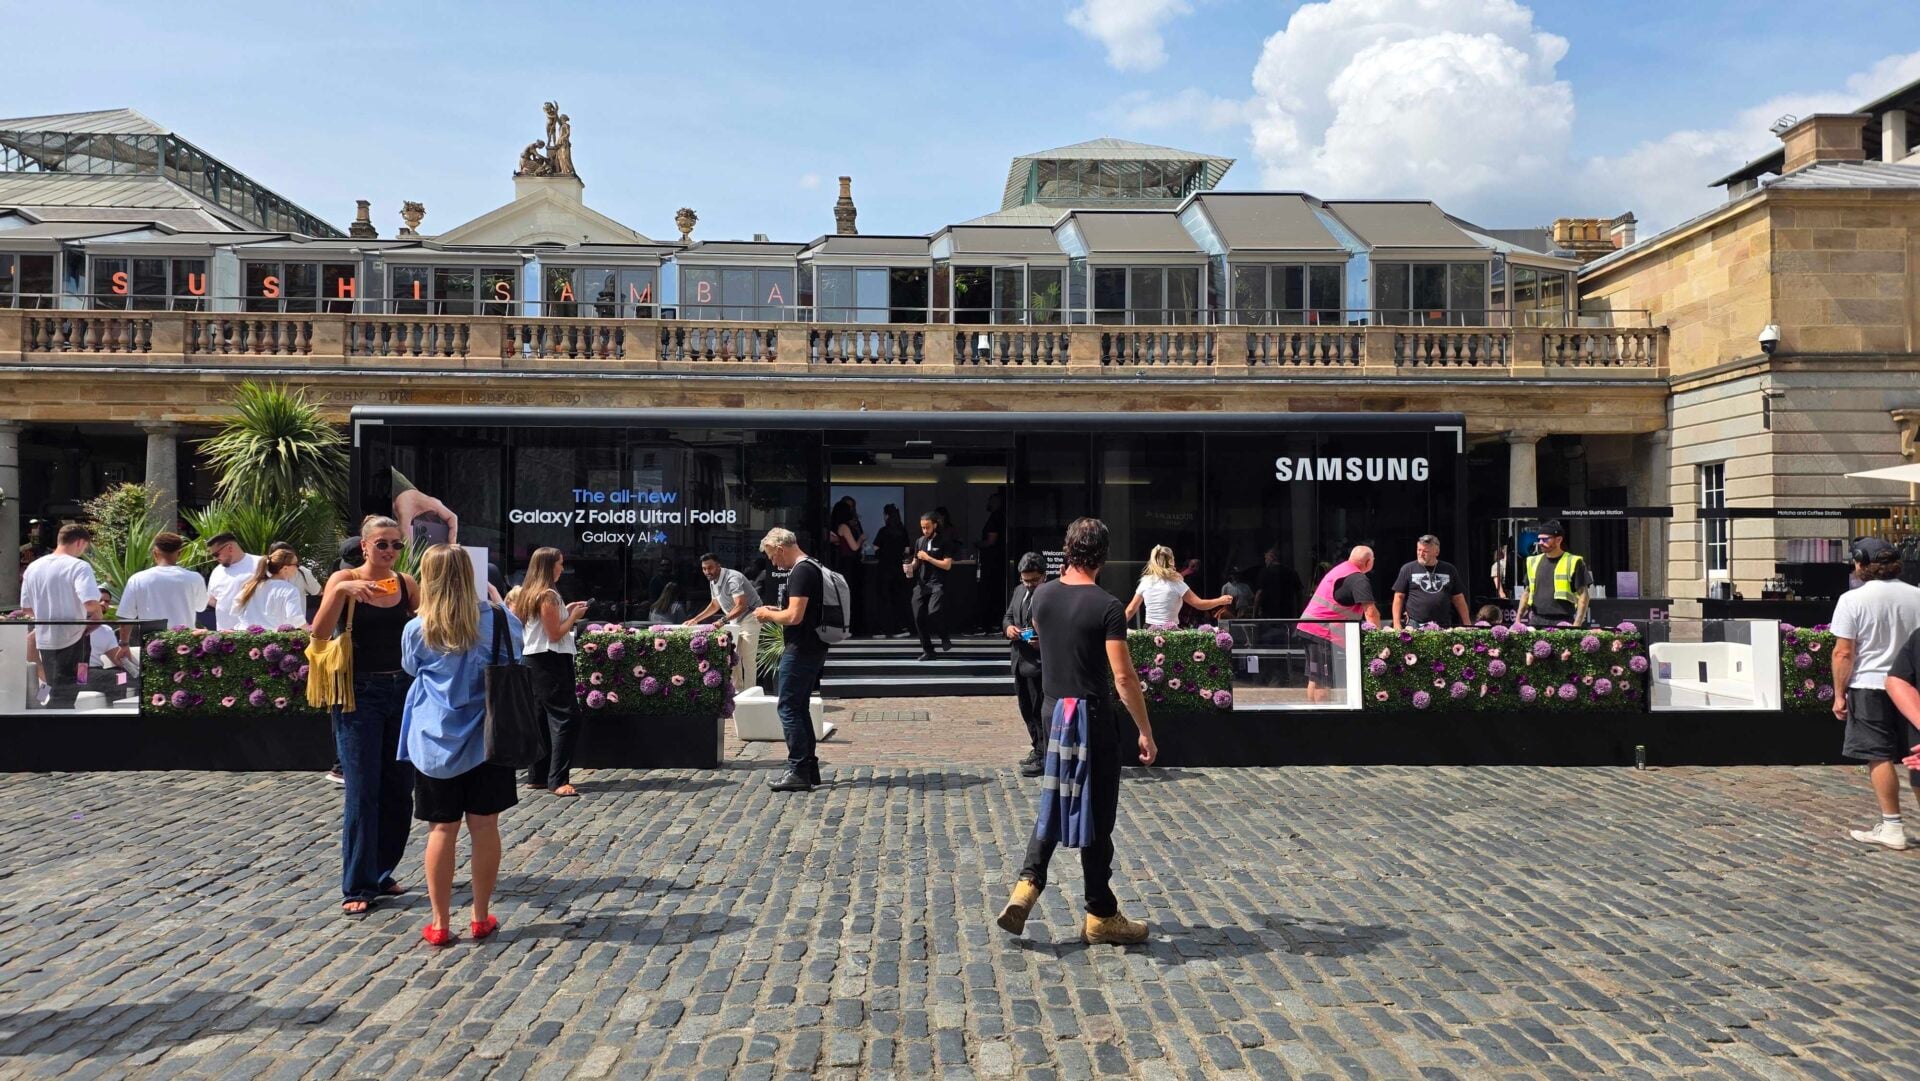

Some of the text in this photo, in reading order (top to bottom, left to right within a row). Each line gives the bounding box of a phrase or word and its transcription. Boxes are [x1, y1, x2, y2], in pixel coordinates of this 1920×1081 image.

[1275, 456, 1429, 482] SAMSUNG
[572, 489, 677, 503] The all-new
[508, 509, 737, 528] Galaxy Z Fold8 Ultra Fold8
[1561, 509, 1588, 517] Electrolyte
[581, 530, 651, 547] Galaxy AI
